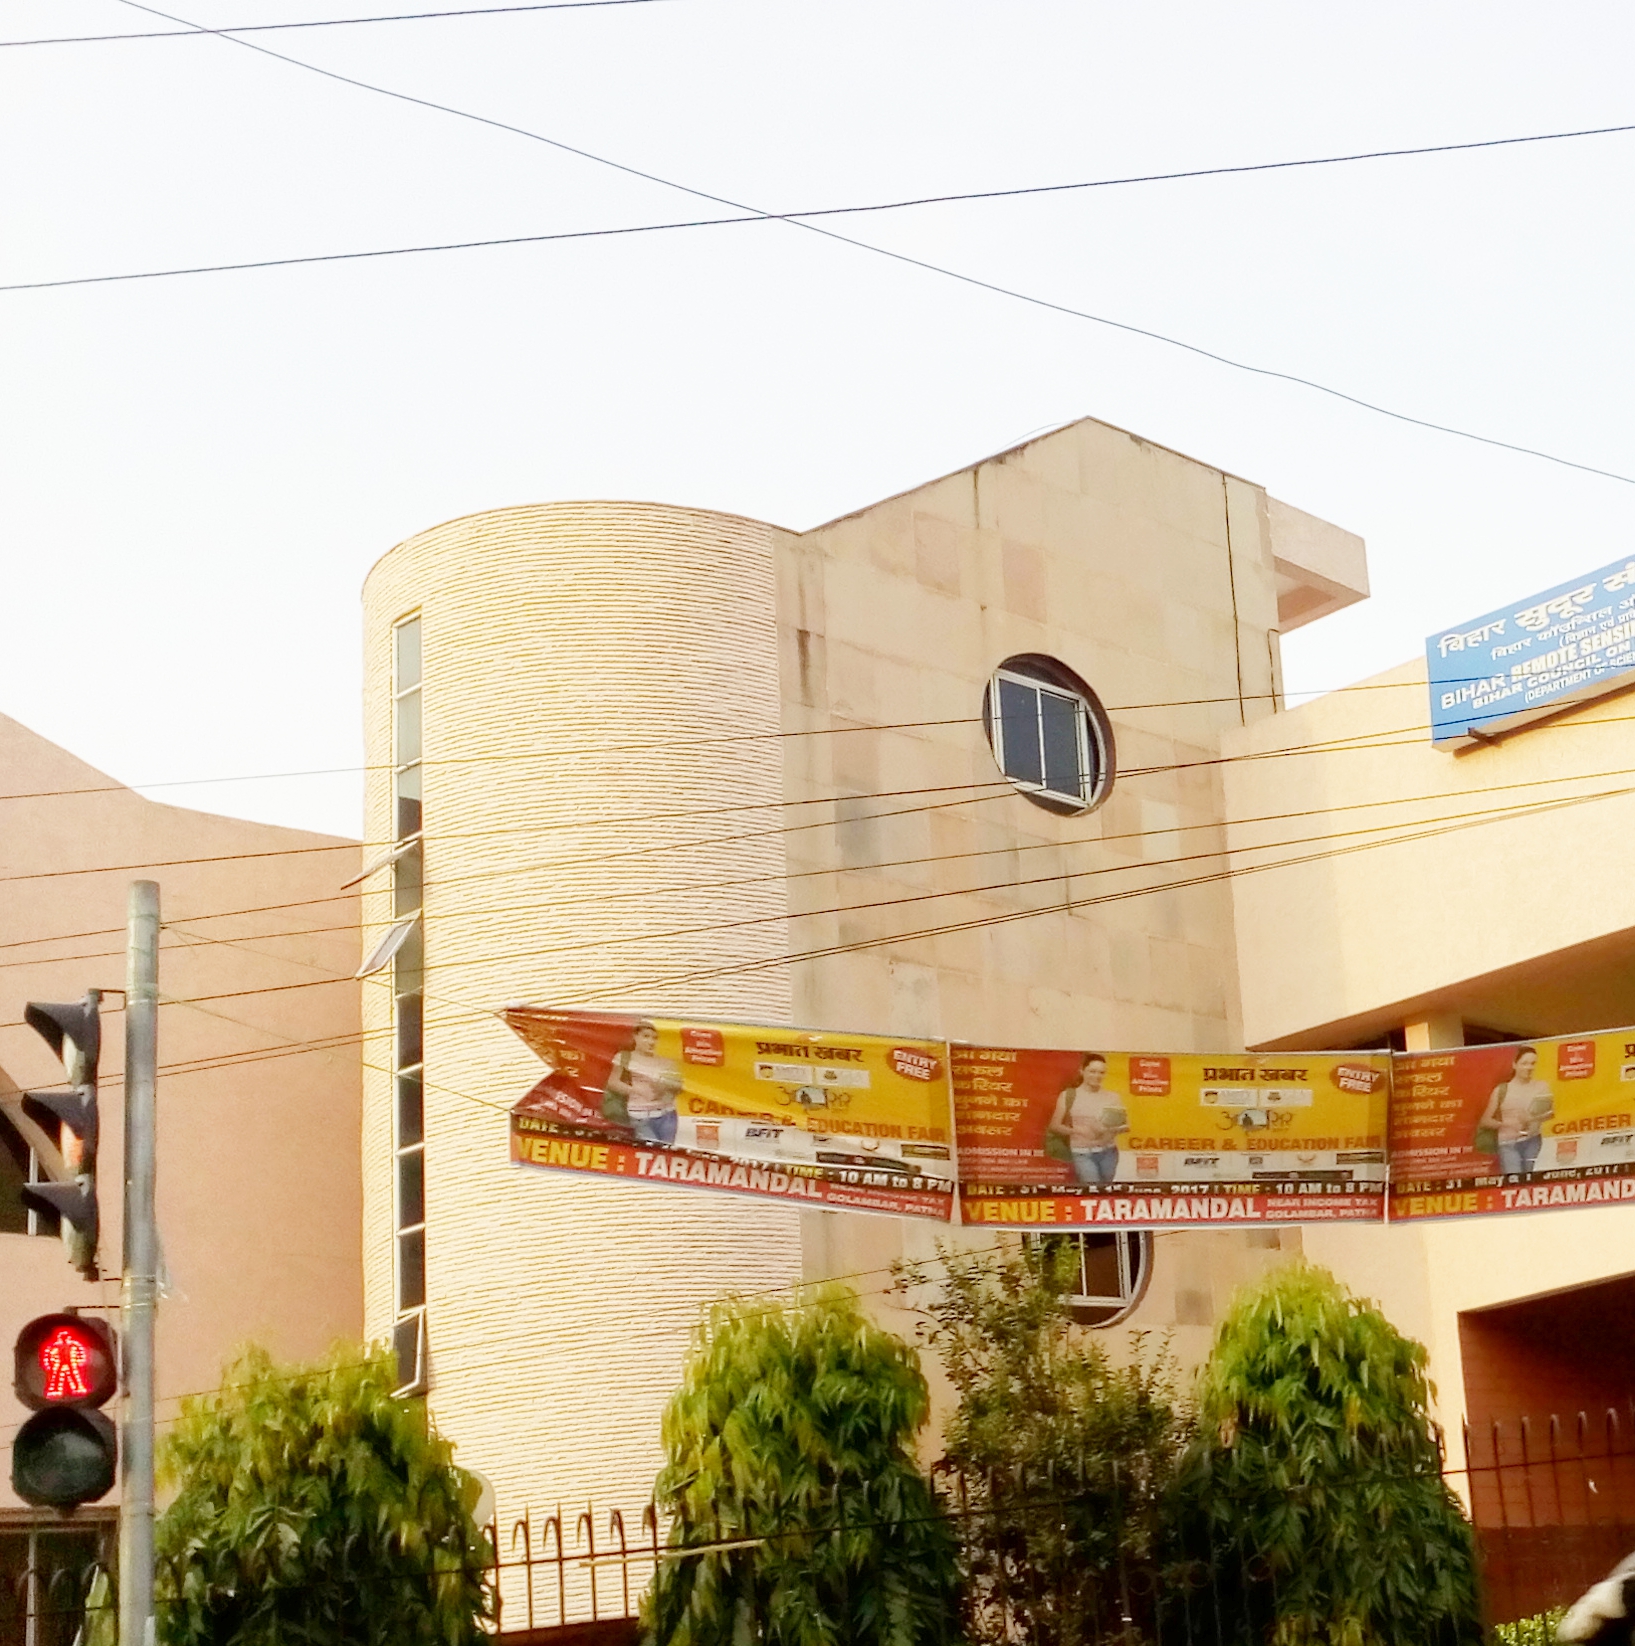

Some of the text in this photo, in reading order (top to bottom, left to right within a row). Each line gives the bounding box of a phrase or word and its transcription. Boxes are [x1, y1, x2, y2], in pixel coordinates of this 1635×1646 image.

[1437, 618, 1507, 658] बिहार
[1514, 583, 1597, 631] सुदूर
[1490, 637, 1532, 661] बिहार
[1441, 673, 1506, 709] BIHAR
[1511, 643, 1578, 682] REMOTE
[1473, 682, 1523, 709] BIHAR
[1527, 654, 1602, 687] COUNCIL
[1606, 640, 1631, 657] ON
[1525, 669, 1591, 704] (DEPARTMENT
[1592, 661, 1607, 675] OF
[756, 1041, 863, 1062] प्रभात खबर
[893, 1049, 938, 1070] ENTRY
[896, 1062, 931, 1080] FREE
[1203, 1068, 1308, 1081] प्रभात खबर
[1339, 1078, 1371, 1093] FREE
[807, 1117, 947, 1141] EDUCATION FAIR
[1553, 1113, 1631, 1134] CAREER
[1130, 1135, 1381, 1150] CAREER & EDUCATION FAIR
[517, 1135, 822, 1199] VENUE TARAMANDAL
[863, 1173, 953, 1193] AM PM
[965, 1198, 1261, 1222] VENUE TARAMANDAL
[1394, 1193, 1478, 1216] VENUE
